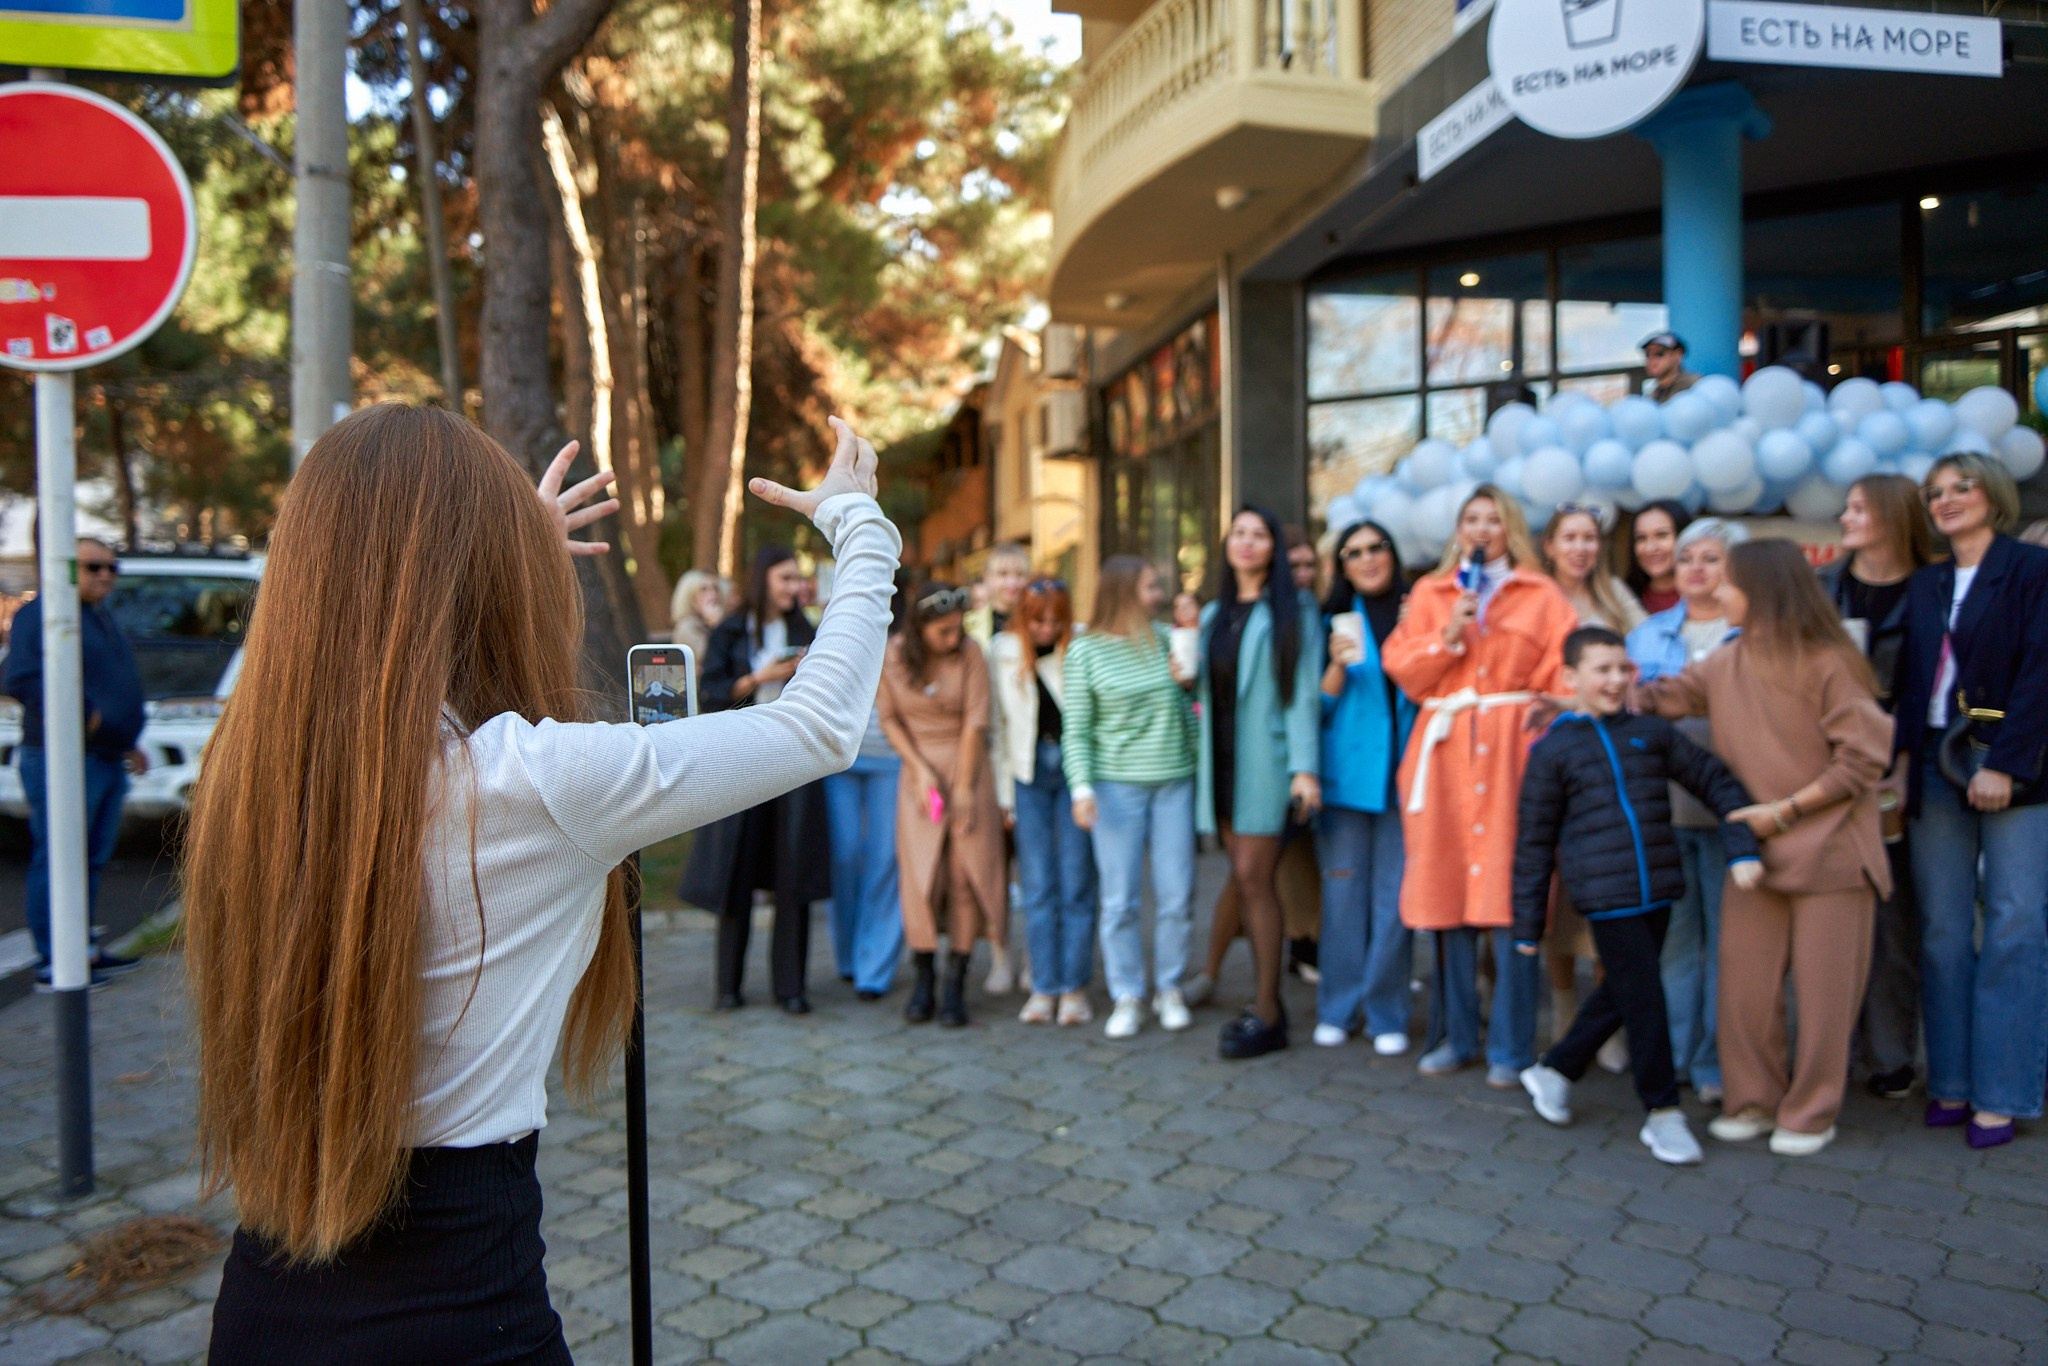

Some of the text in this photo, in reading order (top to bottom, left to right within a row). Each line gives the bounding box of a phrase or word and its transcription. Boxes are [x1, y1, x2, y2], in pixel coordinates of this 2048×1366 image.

[1740, 17, 1971, 58] ЕСТЬ НА МОРЕ
[1512, 44, 1677, 95] ЕСТЬ НА МОРЕ
